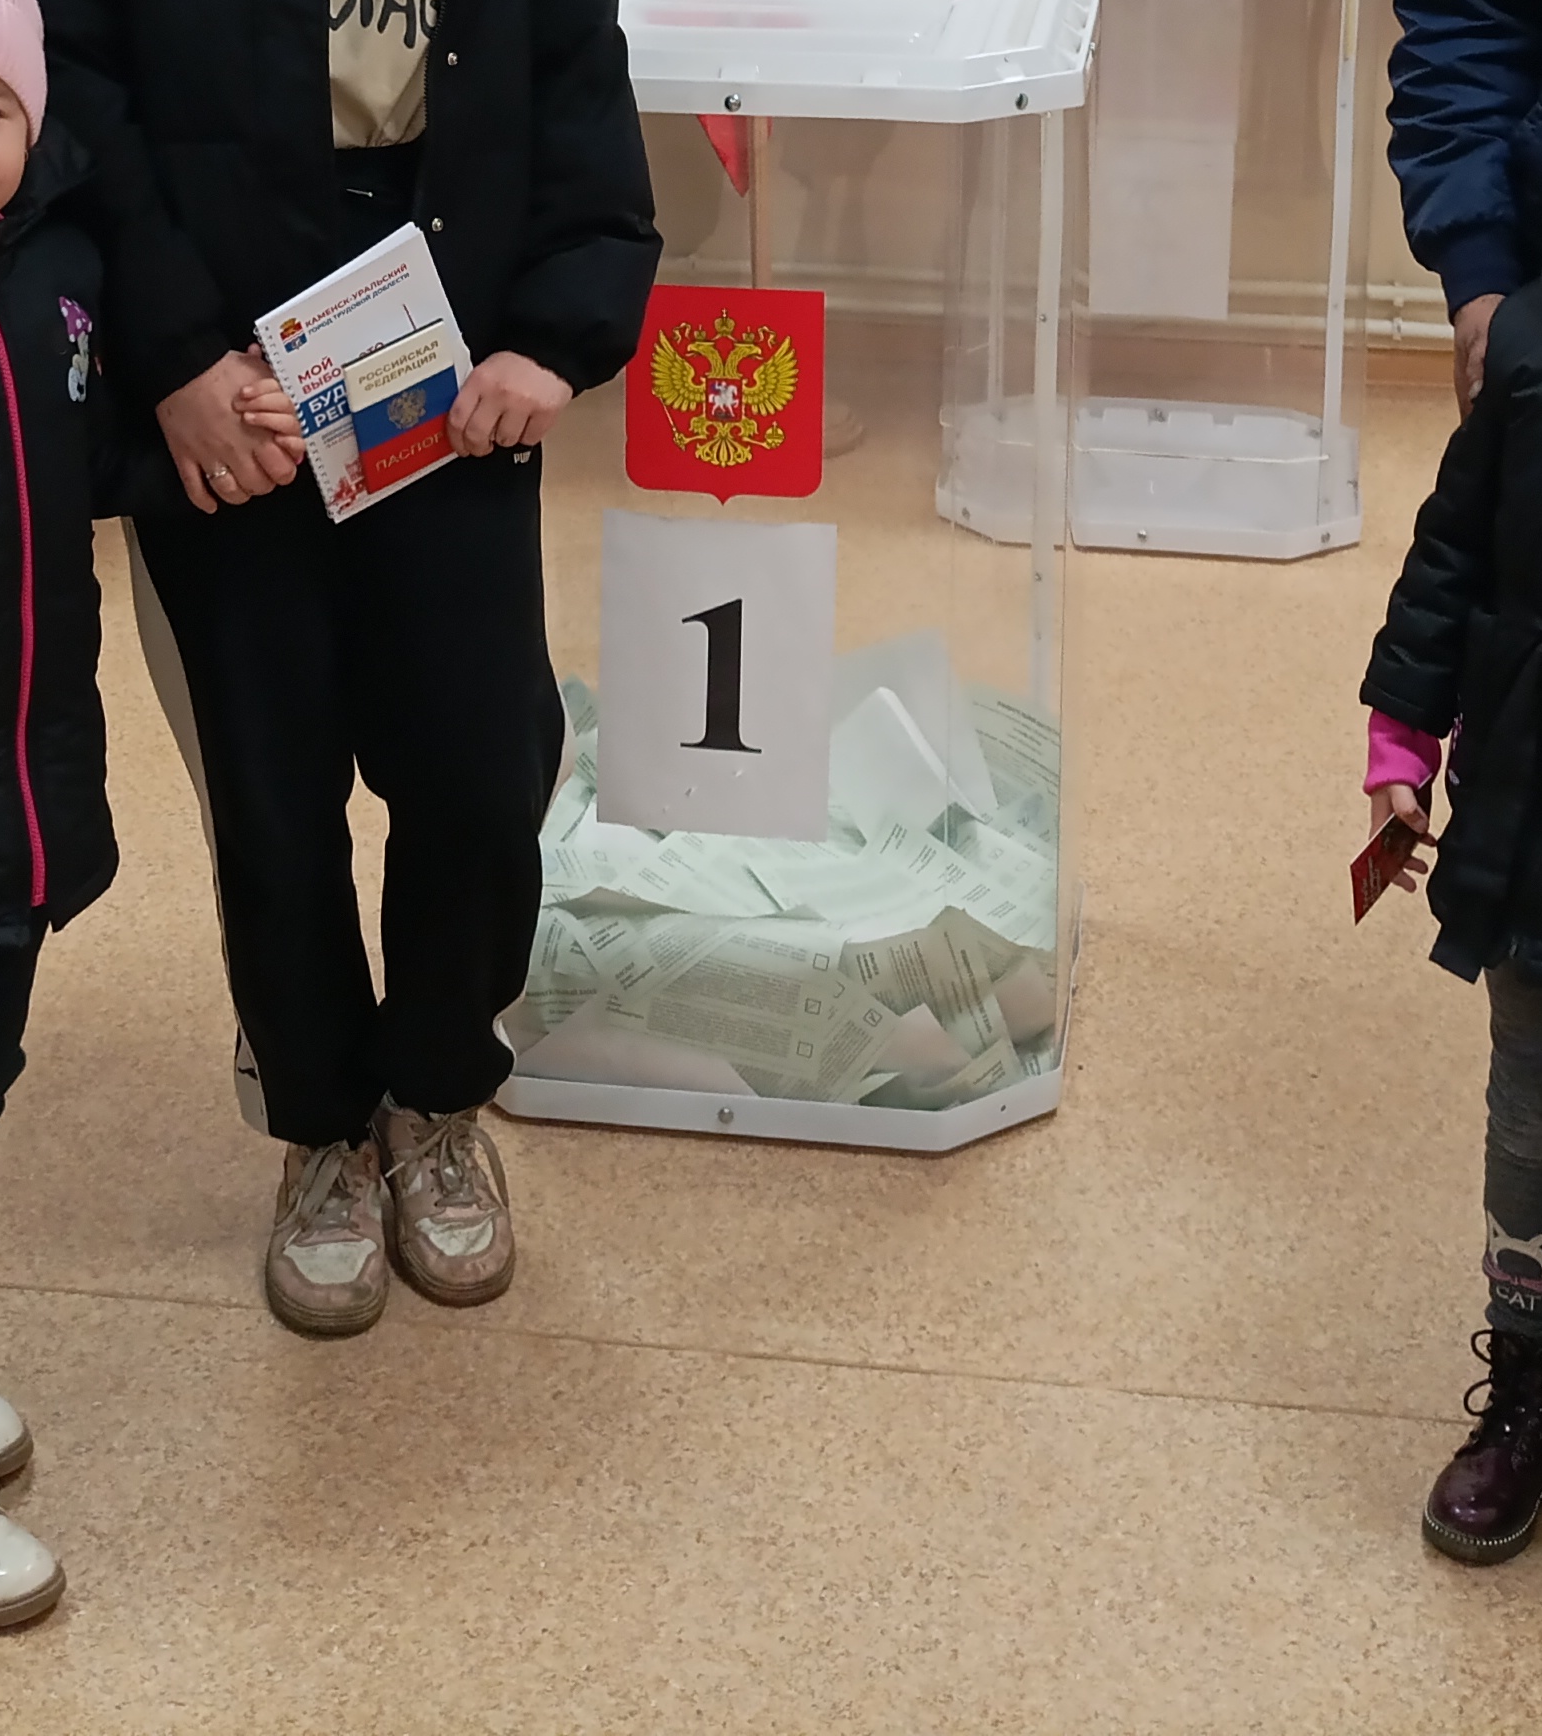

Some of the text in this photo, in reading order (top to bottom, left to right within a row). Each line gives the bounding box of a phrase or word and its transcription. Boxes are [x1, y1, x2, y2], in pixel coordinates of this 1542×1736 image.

[304, 263, 408, 328] КАМЕНСК-УРАЛЬСКИЙ
[308, 272, 410, 335] ГОРОД ТРУДОВОЙ ДОБЛЕСТИ
[297, 355, 334, 385] МОЙ
[358, 340, 439, 385] РОССИЙСКАЯ
[364, 351, 437, 392] ФЕДЕРАЦИЯ
[680, 598, 762, 754] 1
[1496, 1285, 1542, 1312] CAT
